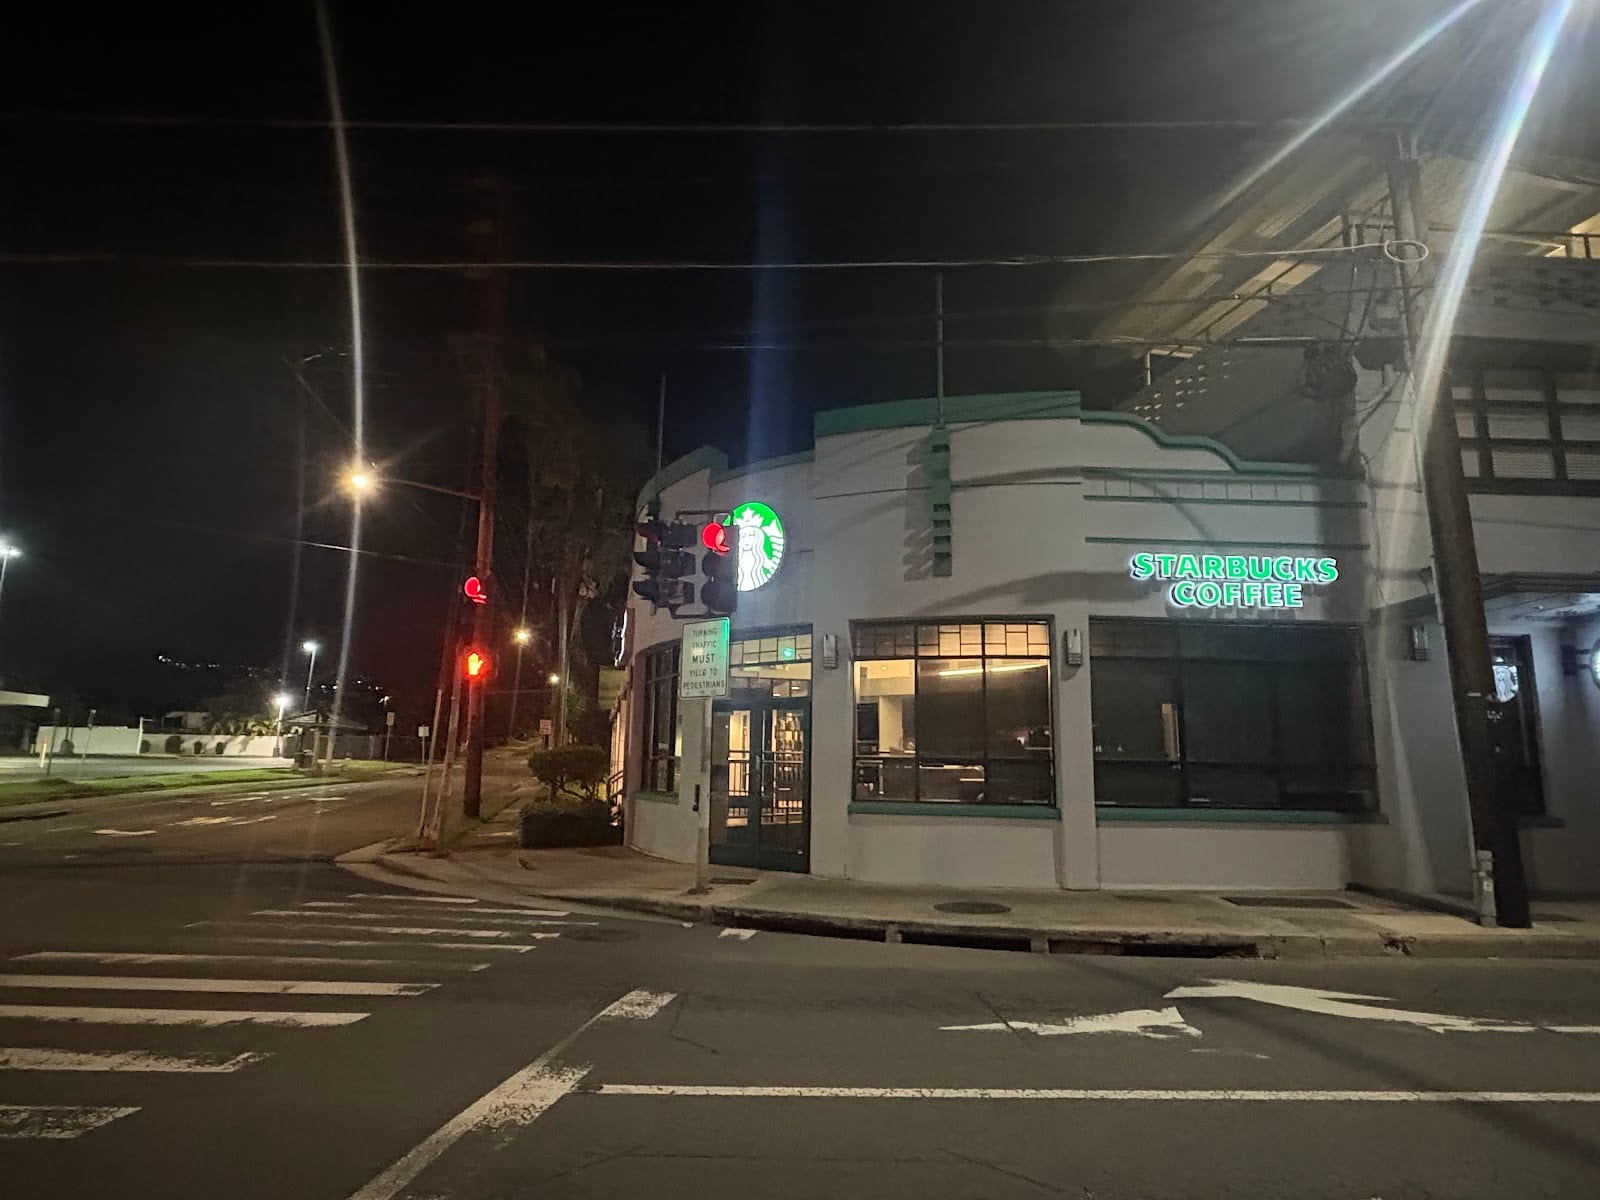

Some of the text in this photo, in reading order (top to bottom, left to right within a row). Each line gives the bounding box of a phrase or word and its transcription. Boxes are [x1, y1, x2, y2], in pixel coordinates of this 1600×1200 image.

[1132, 552, 1339, 582] STARBUCKS
[1170, 580, 1304, 608] COFFEE
[692, 627, 718, 637] TURNING
[692, 640, 718, 649] TRAFFIC
[692, 653, 715, 664] MUST
[689, 667, 718, 678] YIELD TO
[683, 680, 725, 691] PEDESTRIANS
